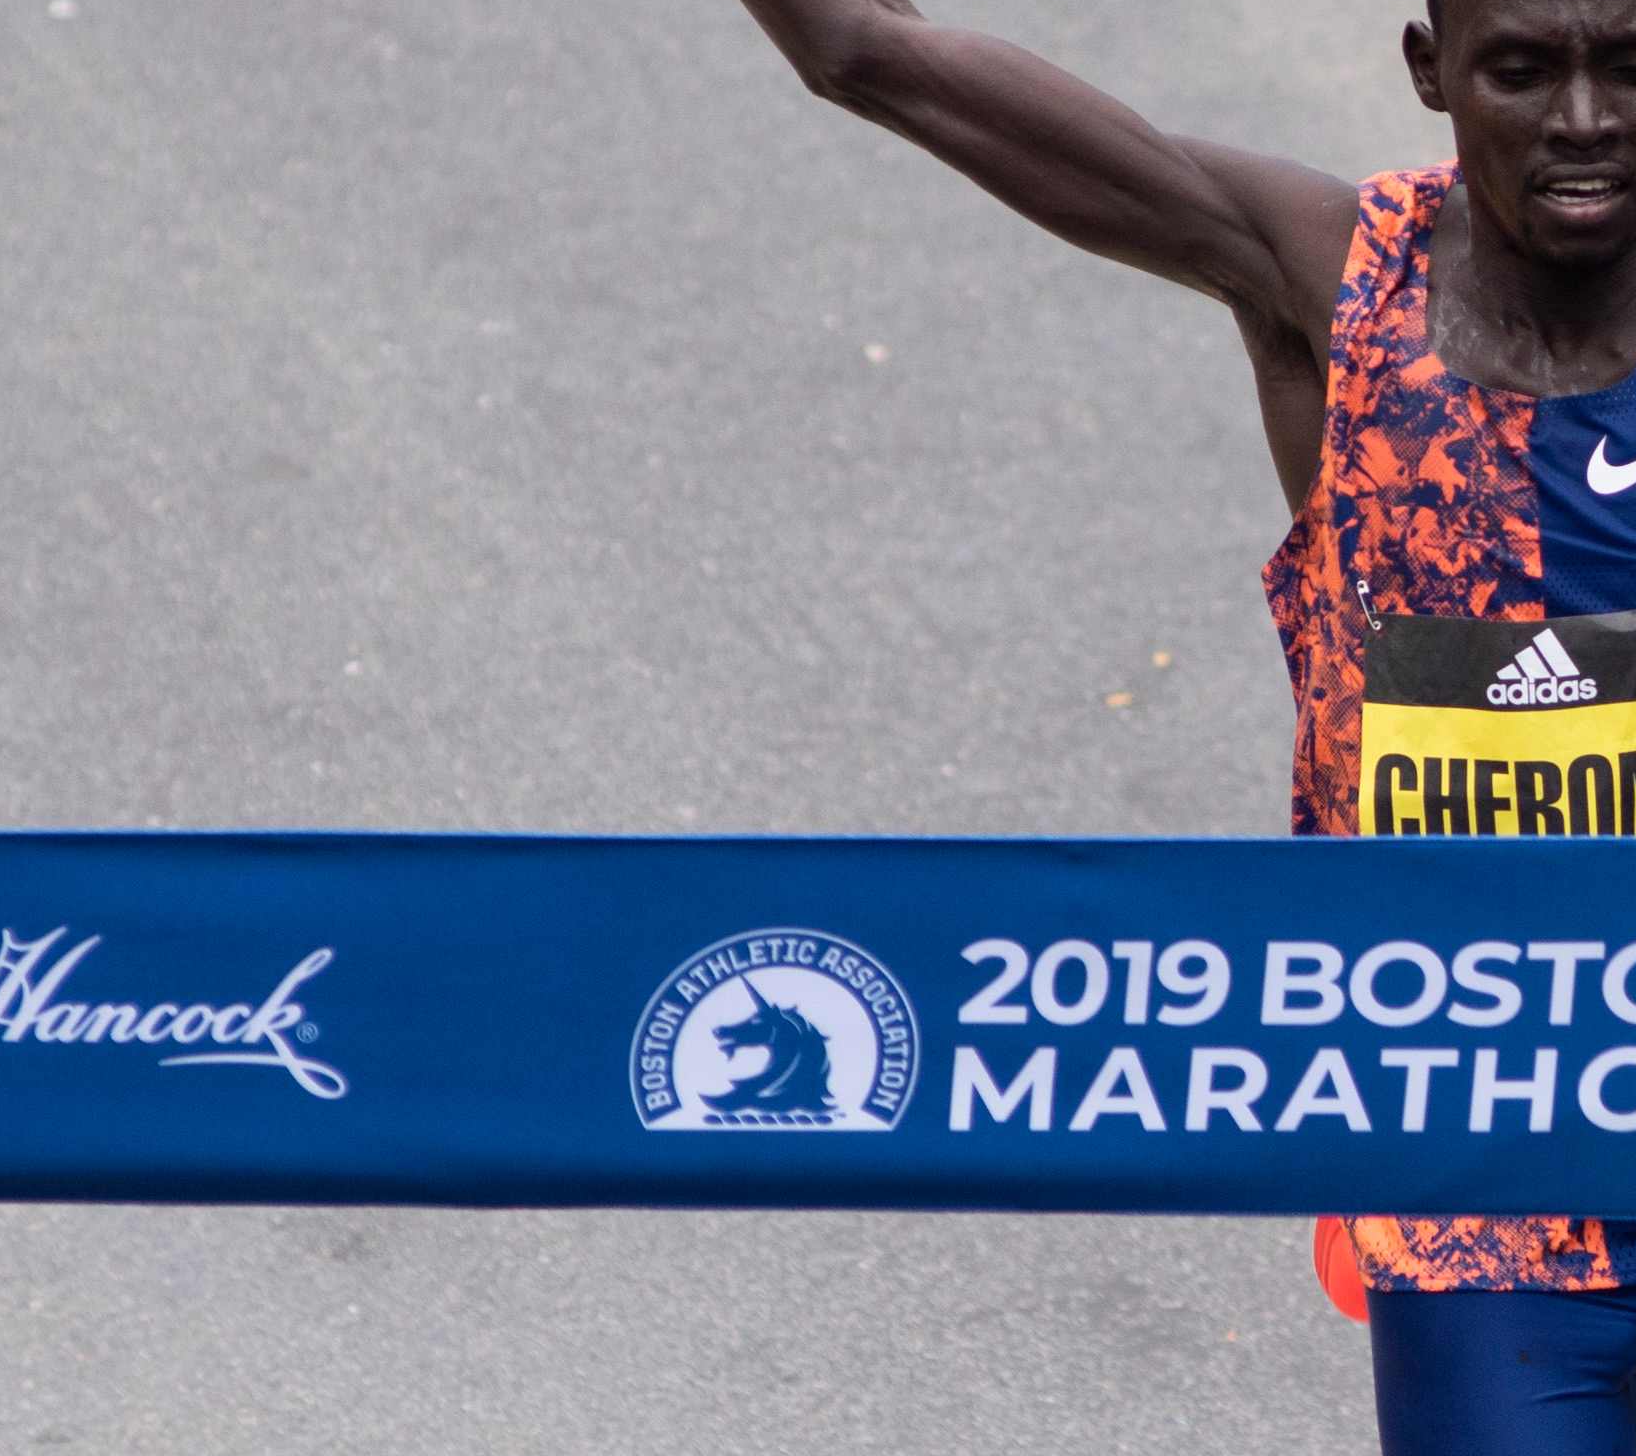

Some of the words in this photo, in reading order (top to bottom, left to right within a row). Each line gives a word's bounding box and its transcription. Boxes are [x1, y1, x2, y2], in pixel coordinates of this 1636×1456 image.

[1486, 674, 1598, 706] adidas
[640, 998, 685, 1112] BOSTON
[674, 937, 818, 1003] ATHLETIC
[816, 945, 910, 1113] ASSOCIATION
[957, 937, 1232, 1027] 2019
